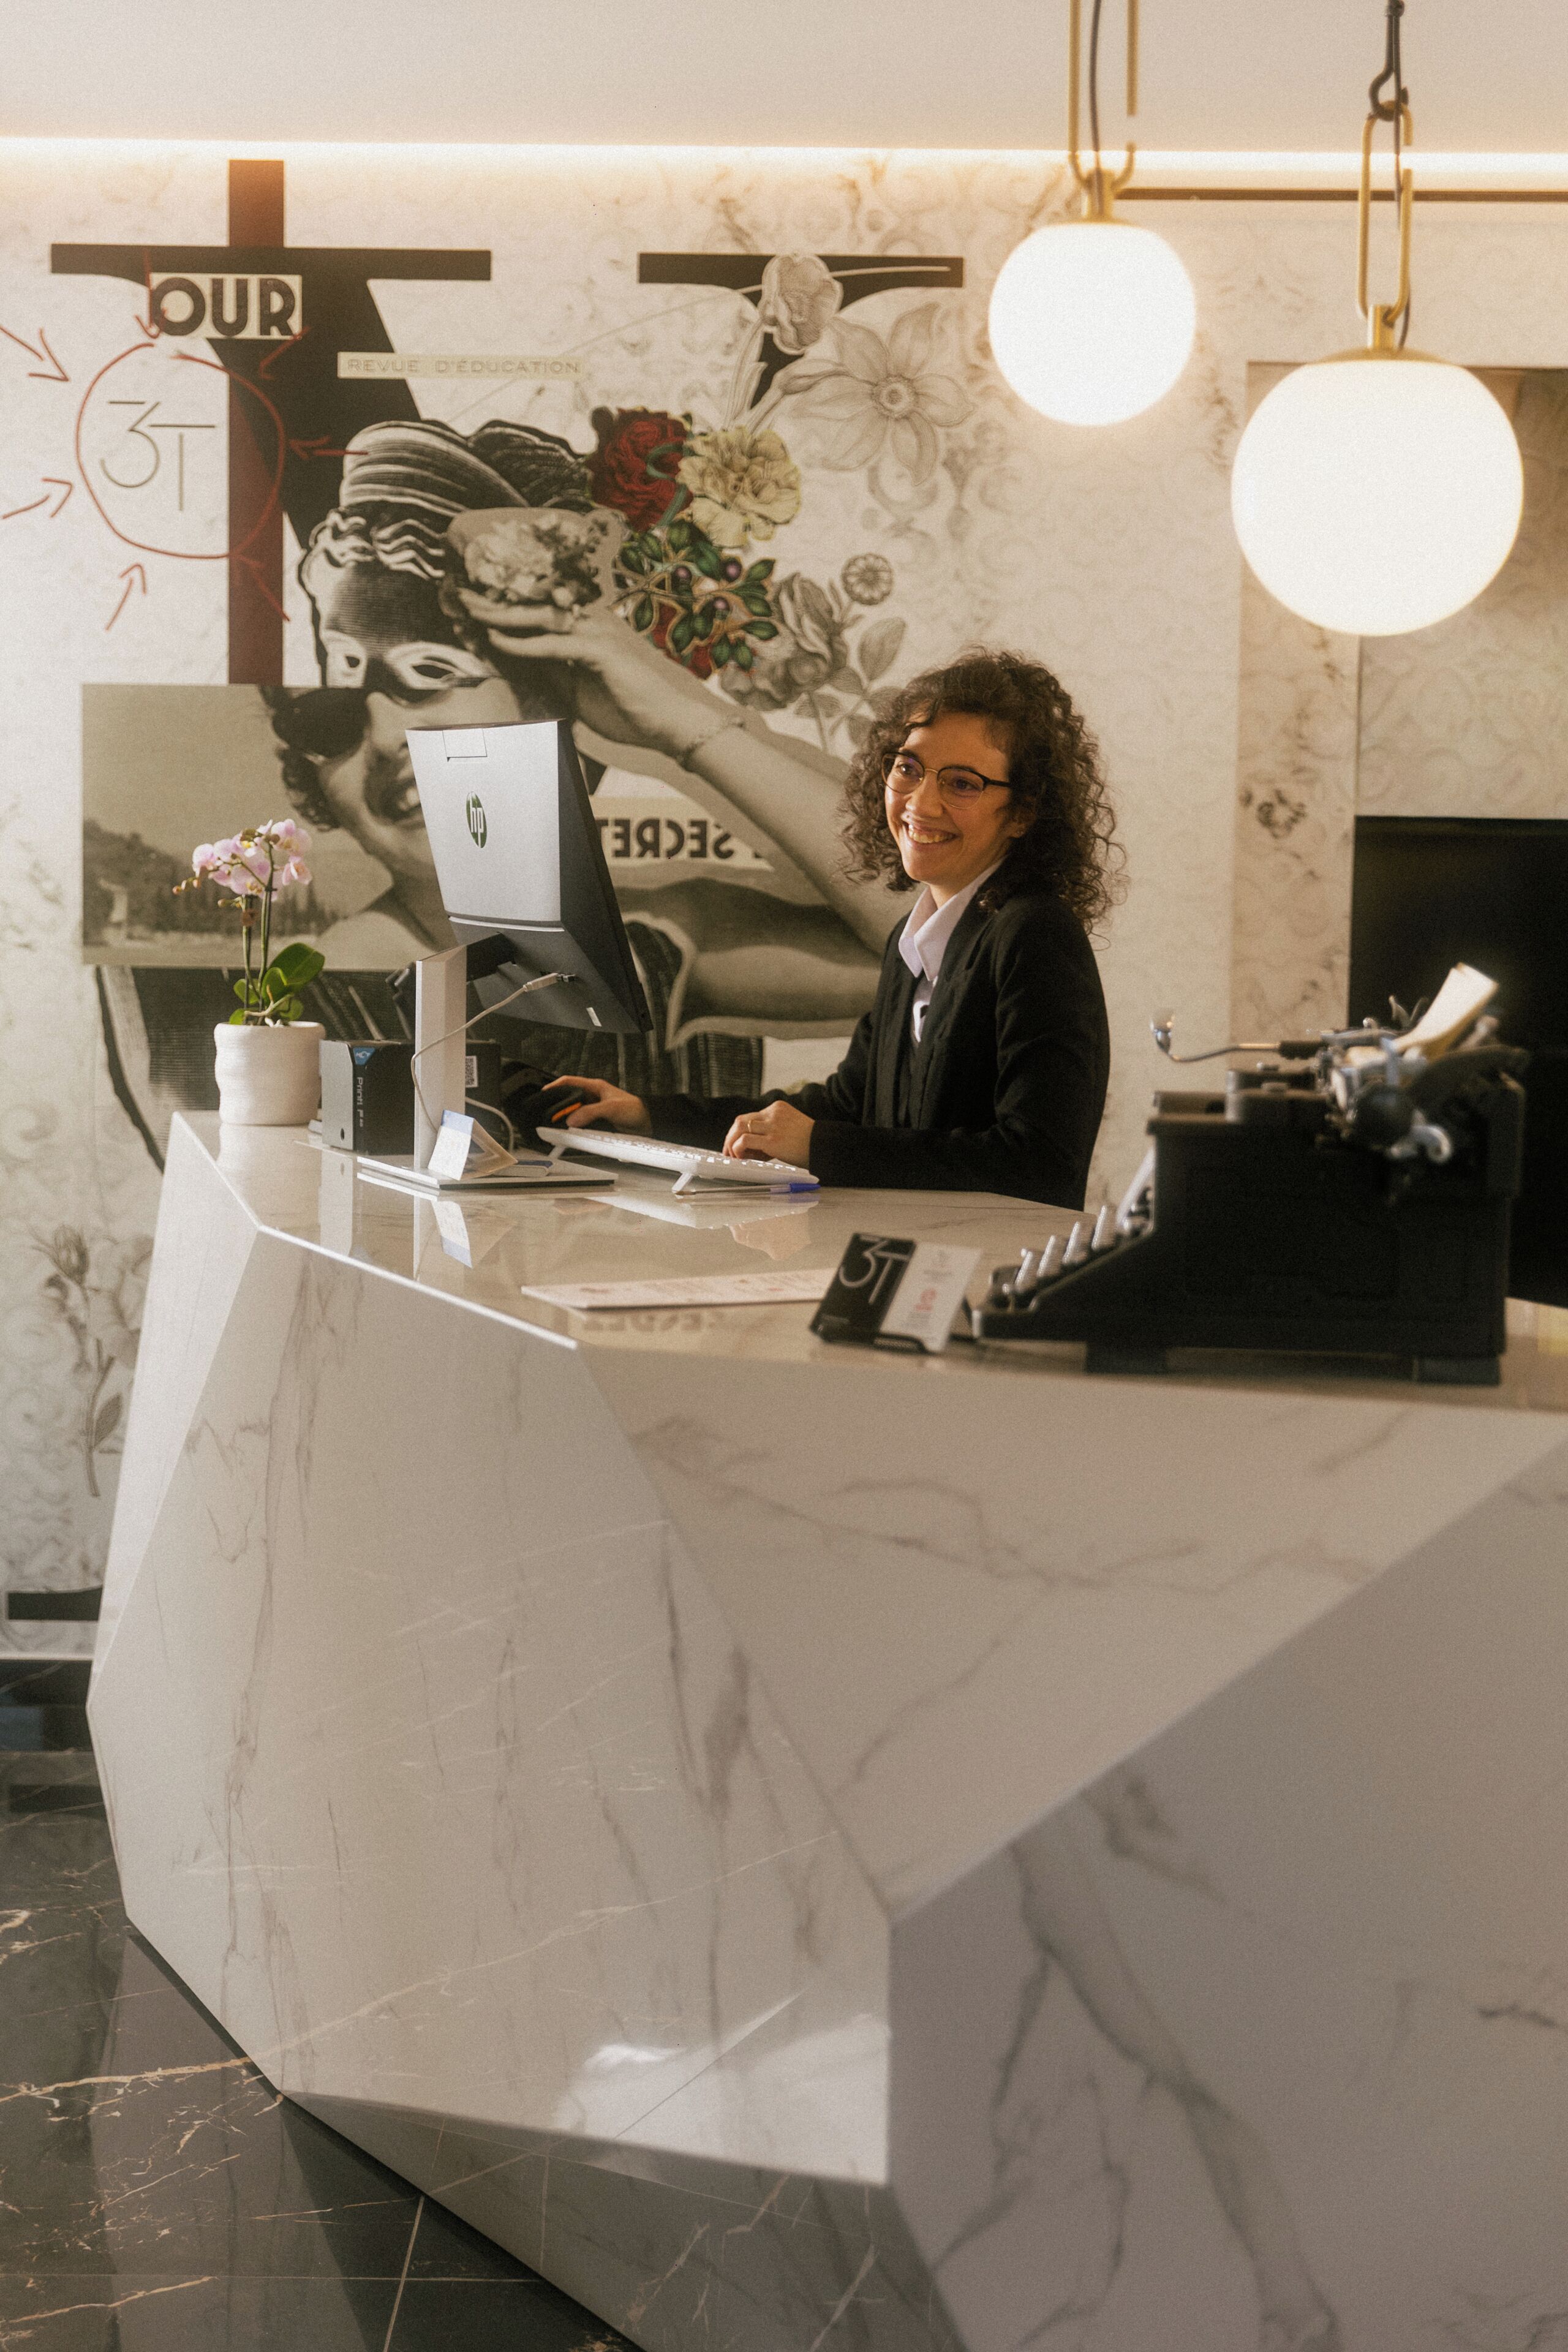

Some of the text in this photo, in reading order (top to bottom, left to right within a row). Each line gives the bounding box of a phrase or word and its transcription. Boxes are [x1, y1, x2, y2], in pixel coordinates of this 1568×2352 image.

[151, 277, 295, 336] OUR
[347, 358, 579, 374] REVUE D'ÉDUCATION
[99, 400, 217, 512] 3T
[469, 792, 484, 848] hp
[839, 1233, 911, 1305] 3T
